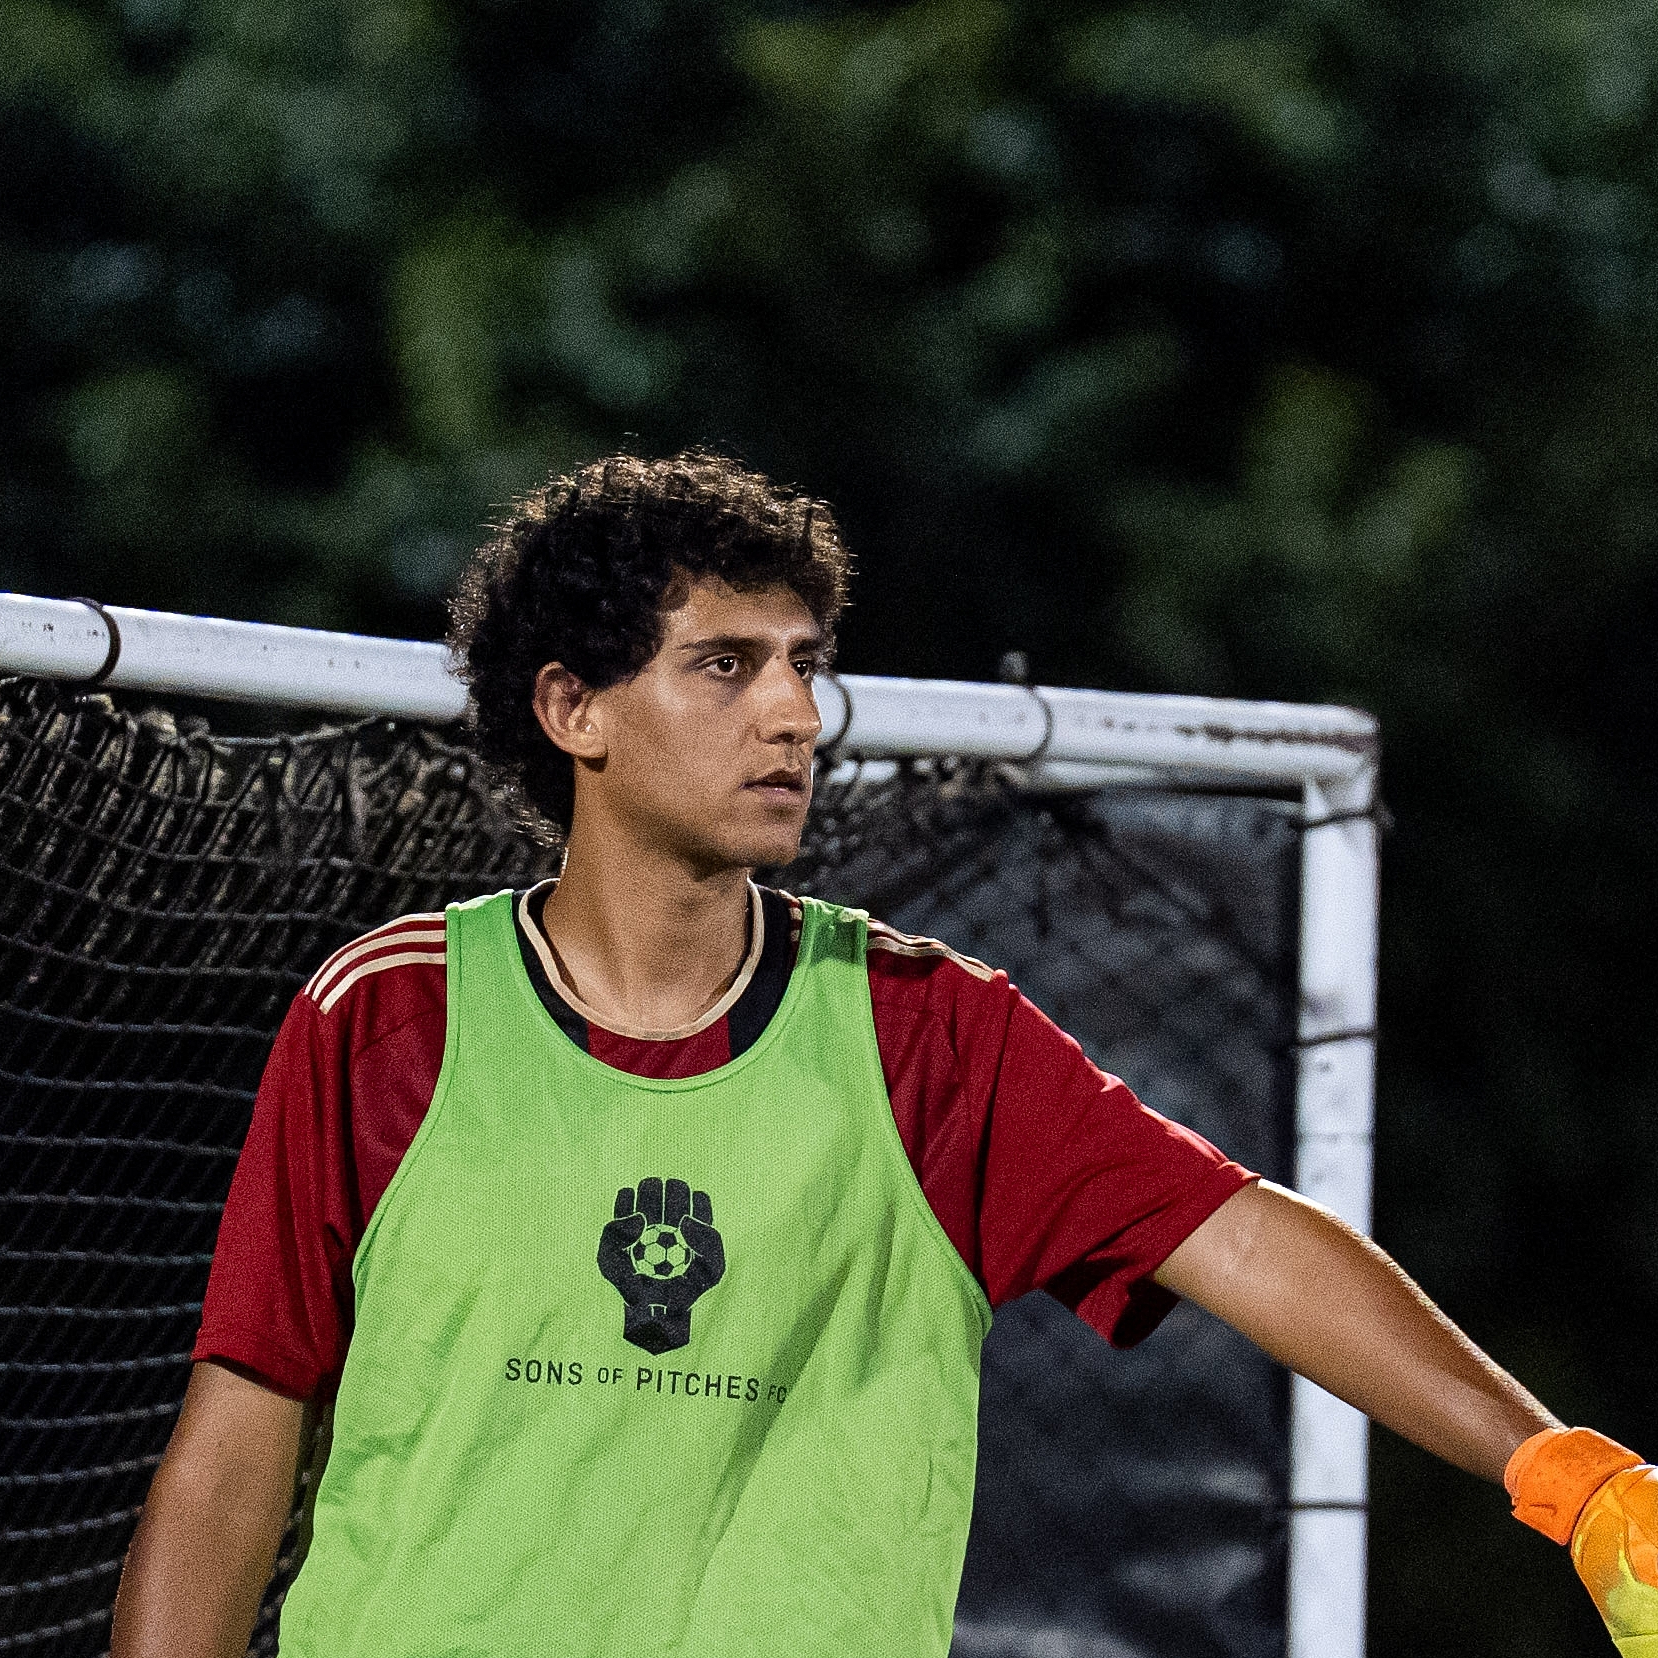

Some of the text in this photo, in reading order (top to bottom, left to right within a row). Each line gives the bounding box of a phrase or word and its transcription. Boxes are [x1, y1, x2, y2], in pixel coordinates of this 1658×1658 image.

[505, 1358, 583, 1385] SONS
[598, 1367, 623, 1384] OF
[636, 1367, 760, 1402] PITCHES
